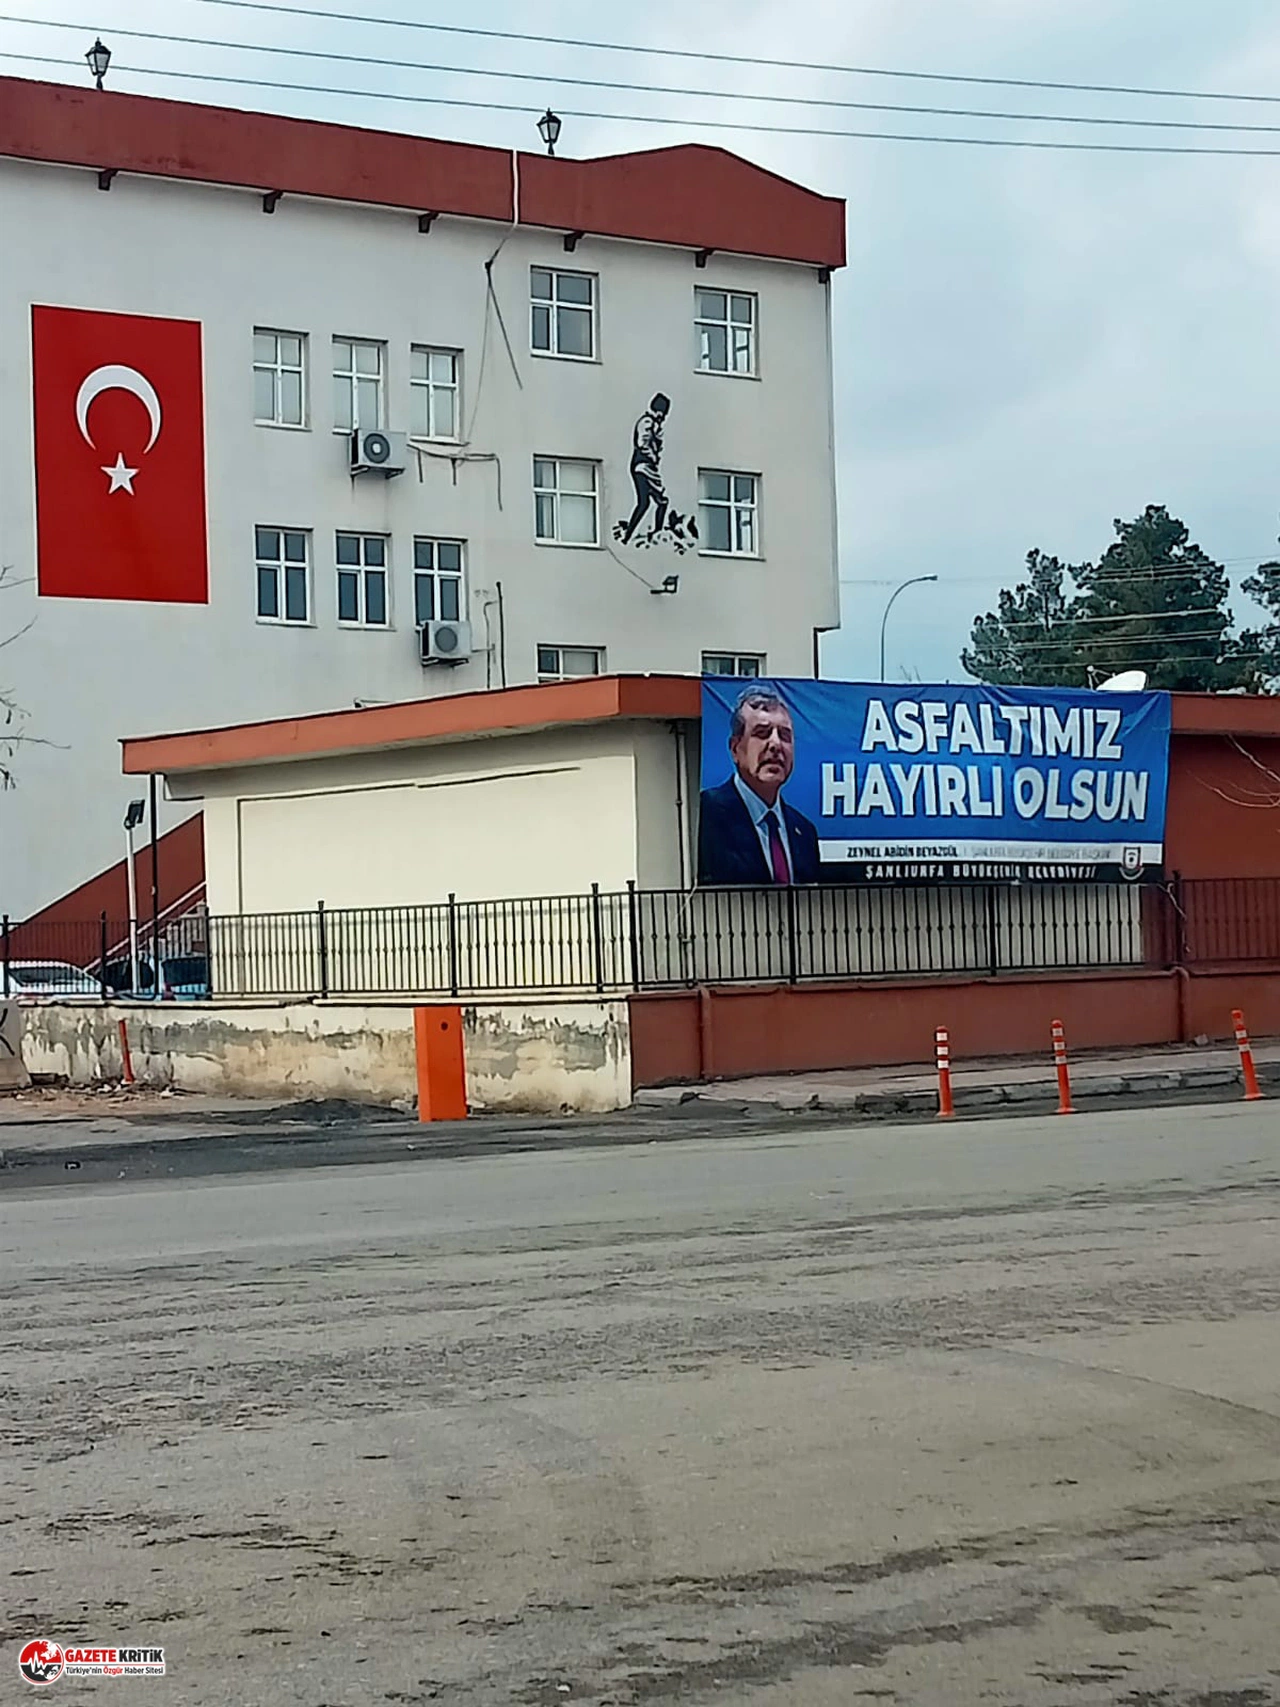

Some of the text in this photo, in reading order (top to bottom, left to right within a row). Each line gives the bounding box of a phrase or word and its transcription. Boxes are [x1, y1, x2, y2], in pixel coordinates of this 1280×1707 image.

[861, 699, 1122, 759] ASFALTIMIZ
[821, 762, 1149, 822] HAYIRLI OLSUN
[847, 846, 882, 858] ZEYNEL
[865, 864, 945, 879] ŞANLIURFA
